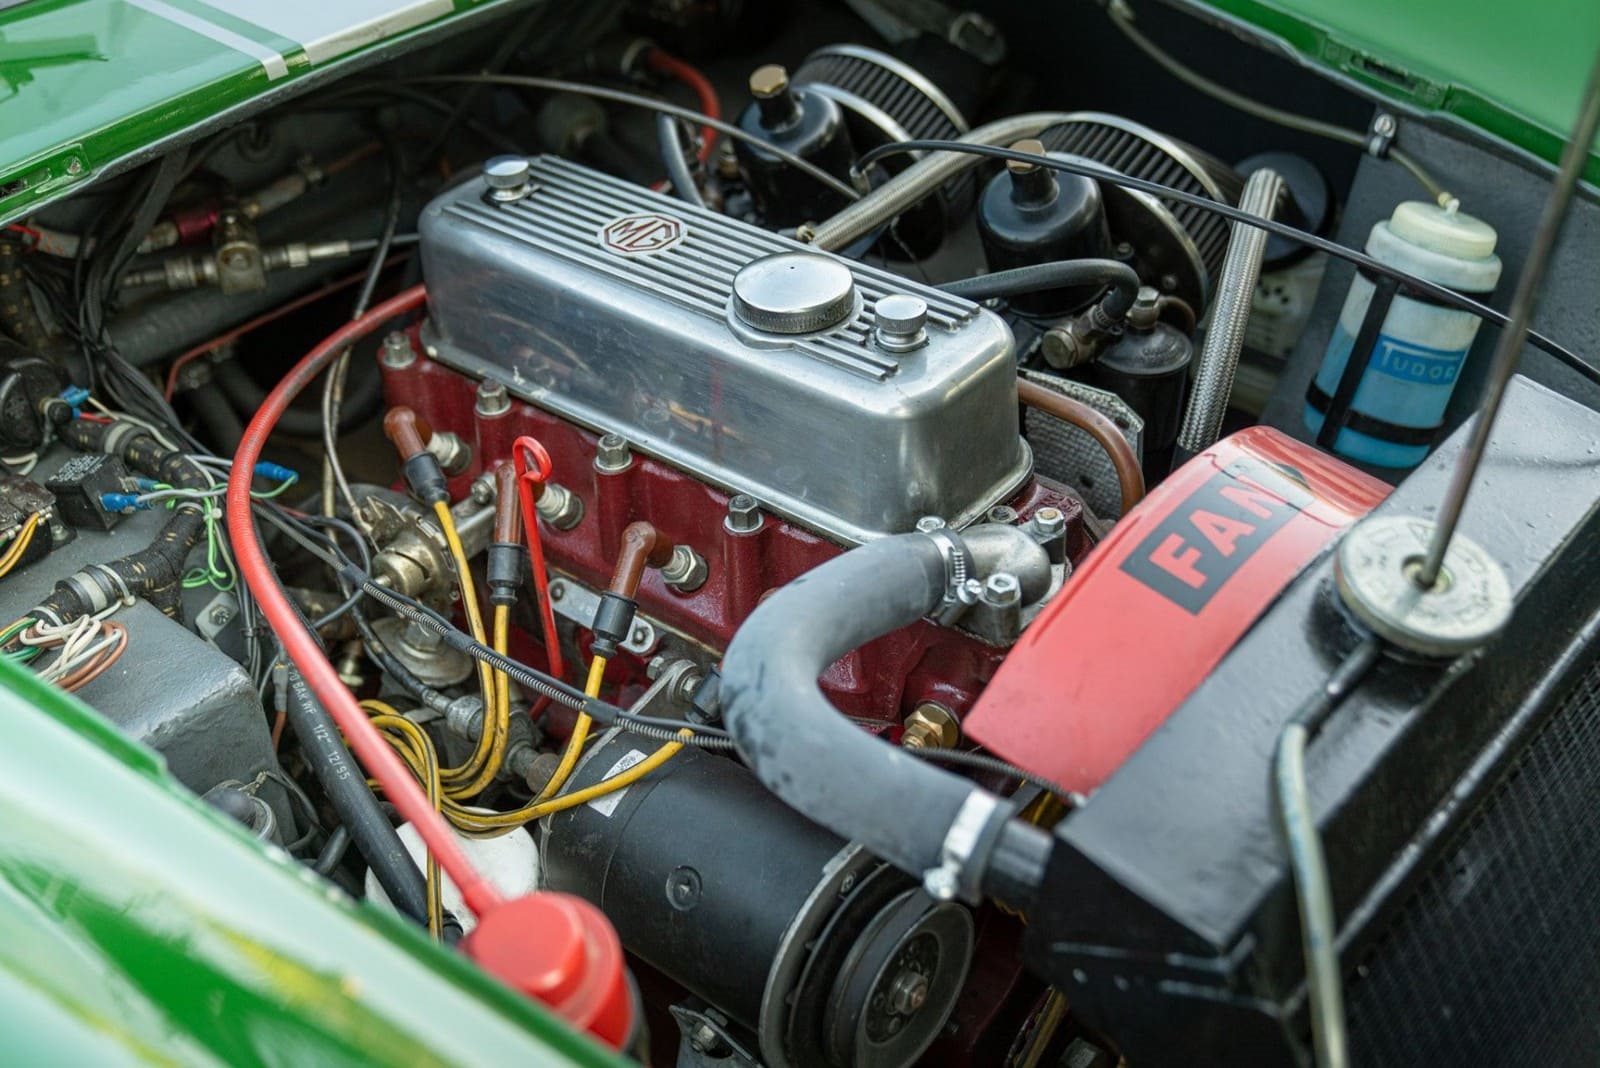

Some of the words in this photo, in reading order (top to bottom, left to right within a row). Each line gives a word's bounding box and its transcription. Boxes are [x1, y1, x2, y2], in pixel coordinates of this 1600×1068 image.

[610, 219, 673, 248] MG
[1382, 340, 1460, 379] TUDOR
[1148, 474, 1289, 589] FAN
[328, 750, 351, 780] 12/95
